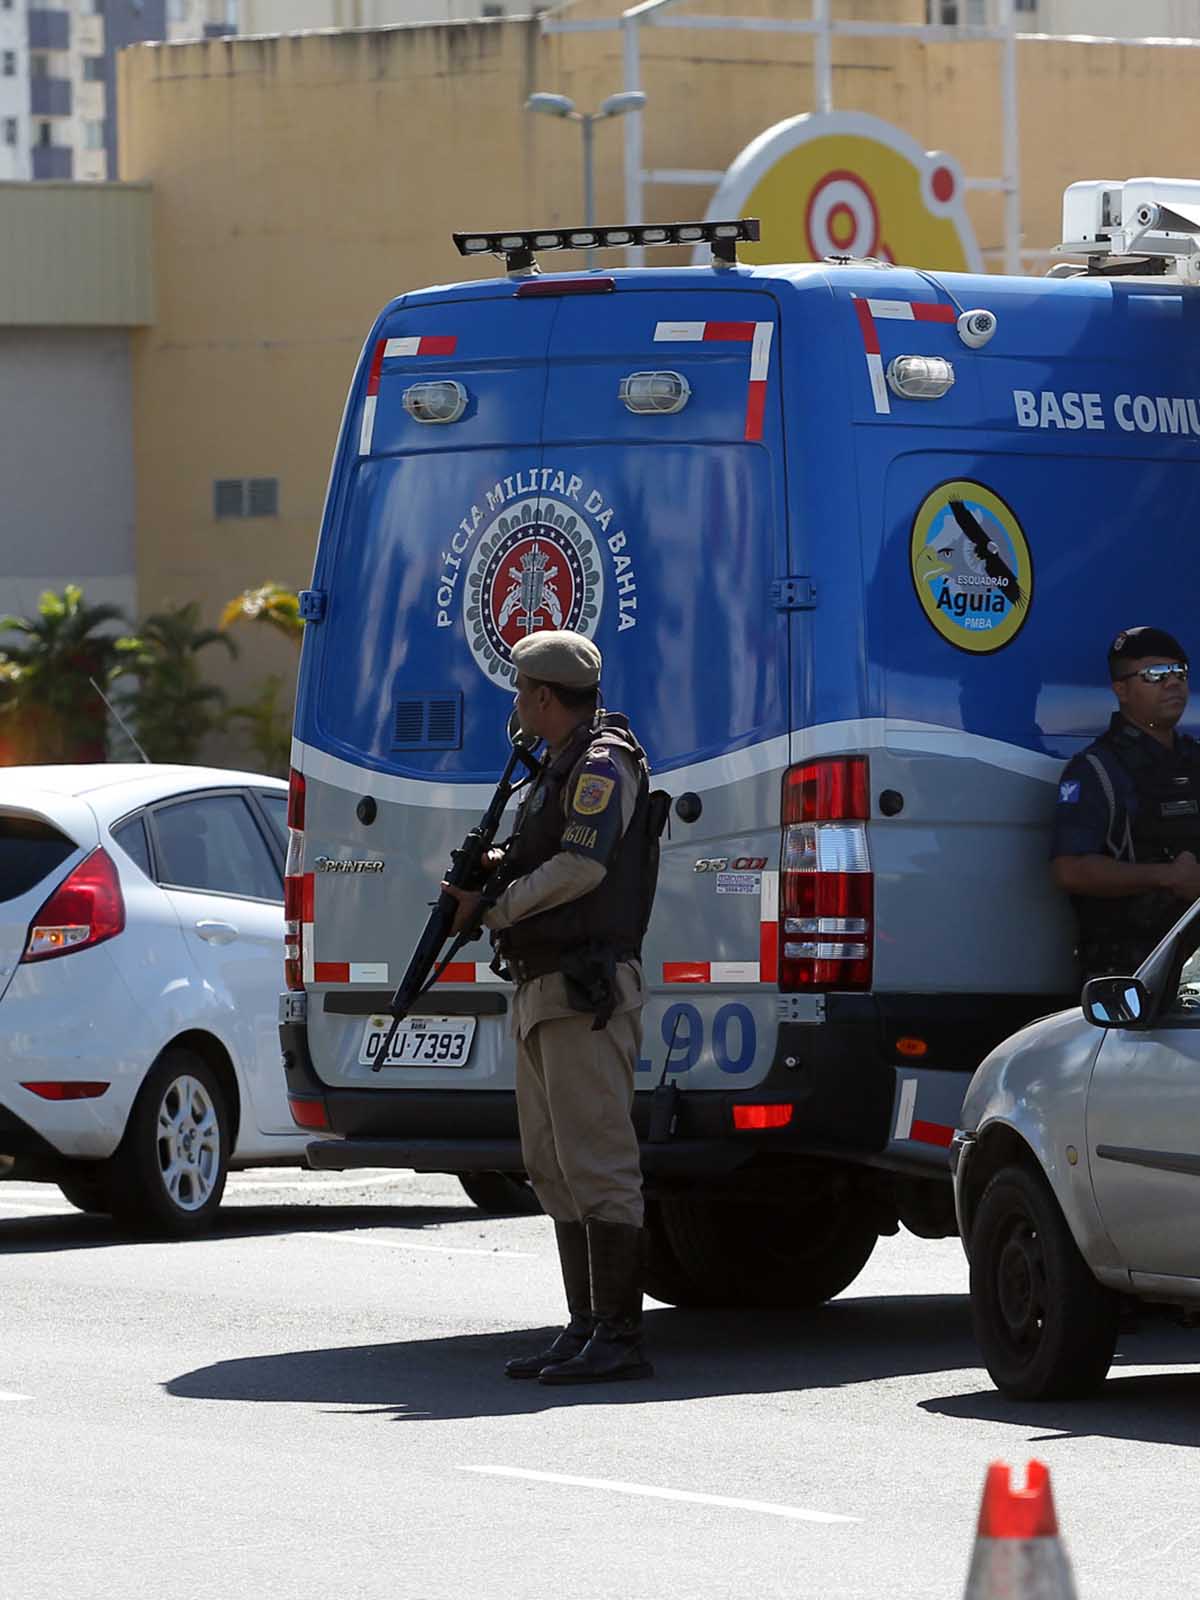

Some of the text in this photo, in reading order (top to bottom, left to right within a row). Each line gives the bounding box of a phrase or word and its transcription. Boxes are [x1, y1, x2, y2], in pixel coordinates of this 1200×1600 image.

[1013, 390, 1104, 430] BASE
[437, 468, 638, 632] POLÍCIA MILITAR DA BAHIA
[957, 575, 1009, 587] ESQUADRÃO
[936, 578, 1006, 616] Águia
[964, 617, 993, 630] PMBA
[313, 856, 385, 874] SPRINTER
[731, 857, 769, 871] CDI
[635, 1003, 758, 1075] 90
